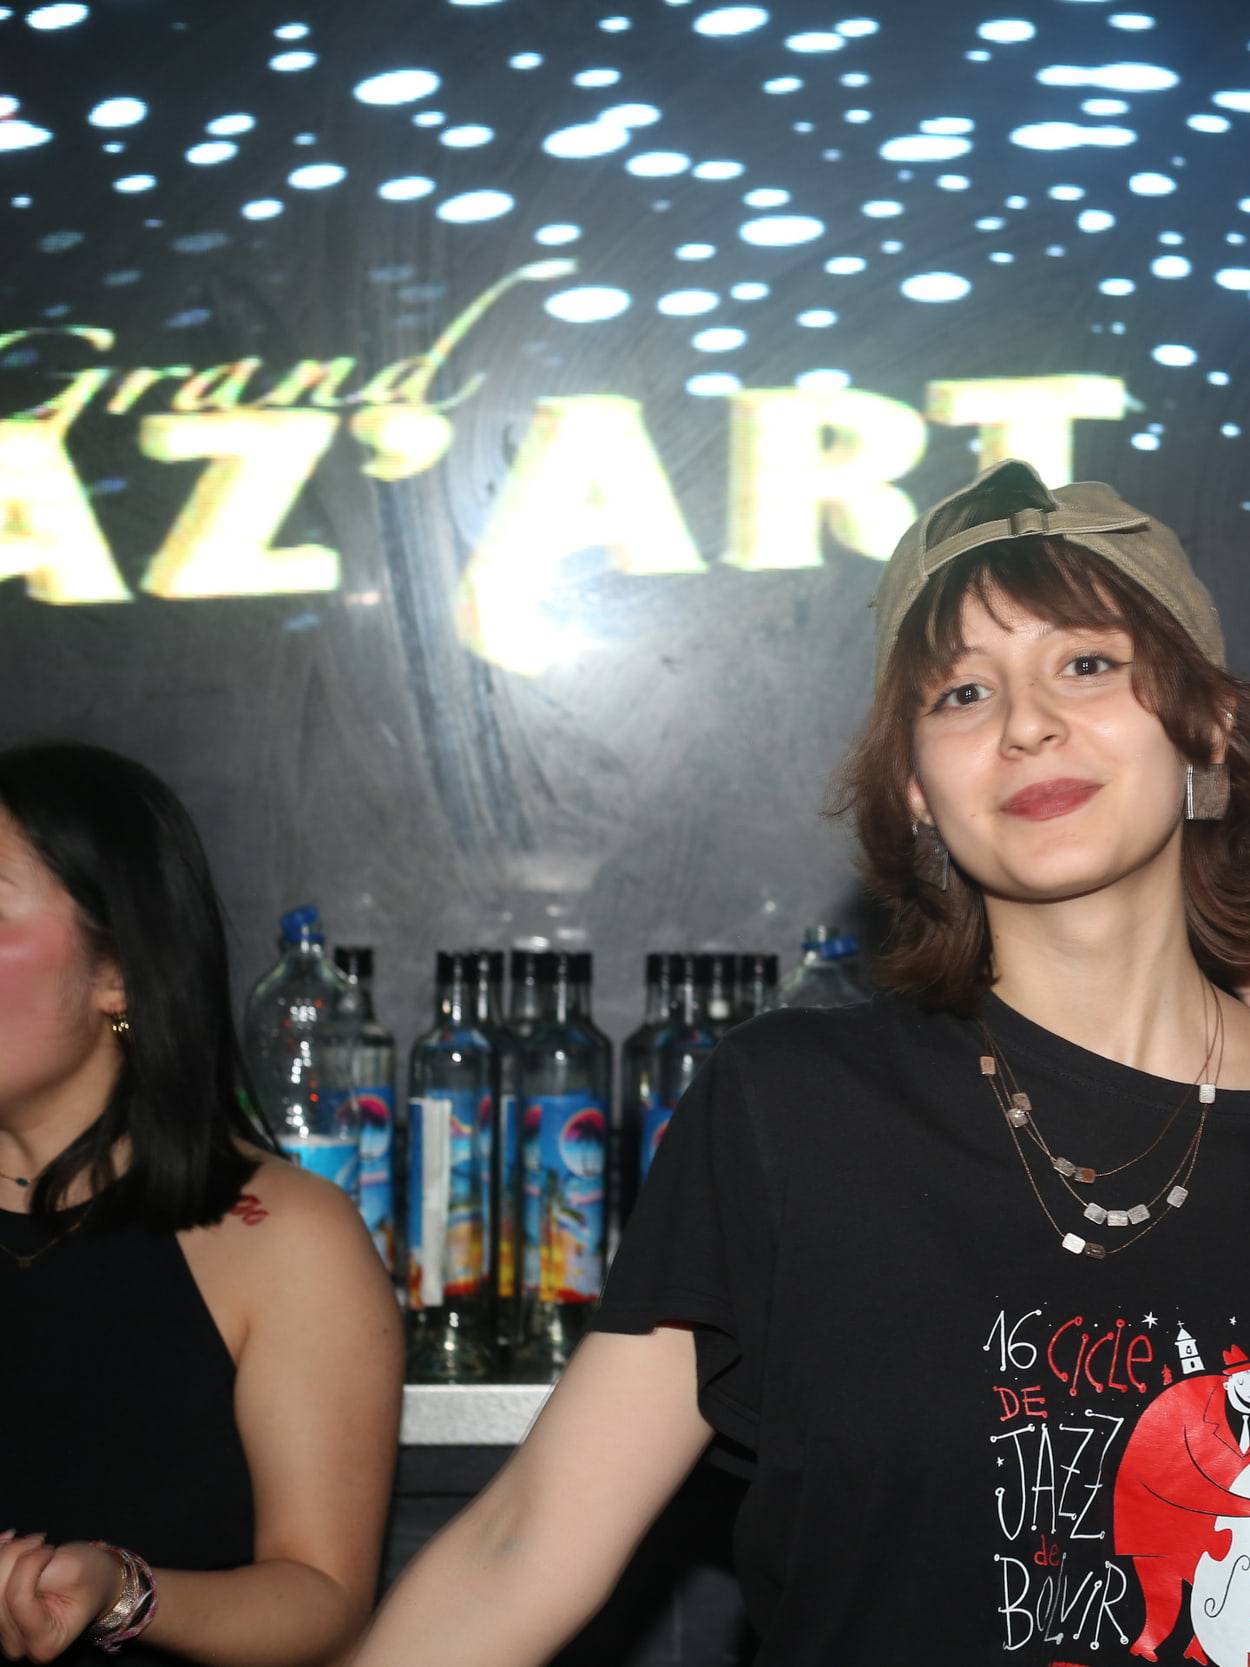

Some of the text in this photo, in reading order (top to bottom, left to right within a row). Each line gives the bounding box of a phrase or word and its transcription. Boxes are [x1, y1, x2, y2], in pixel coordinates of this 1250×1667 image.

[983, 1309, 1043, 1371] 16
[993, 1385, 1049, 1421] DE
[990, 1409, 1125, 1540] JAZZ
